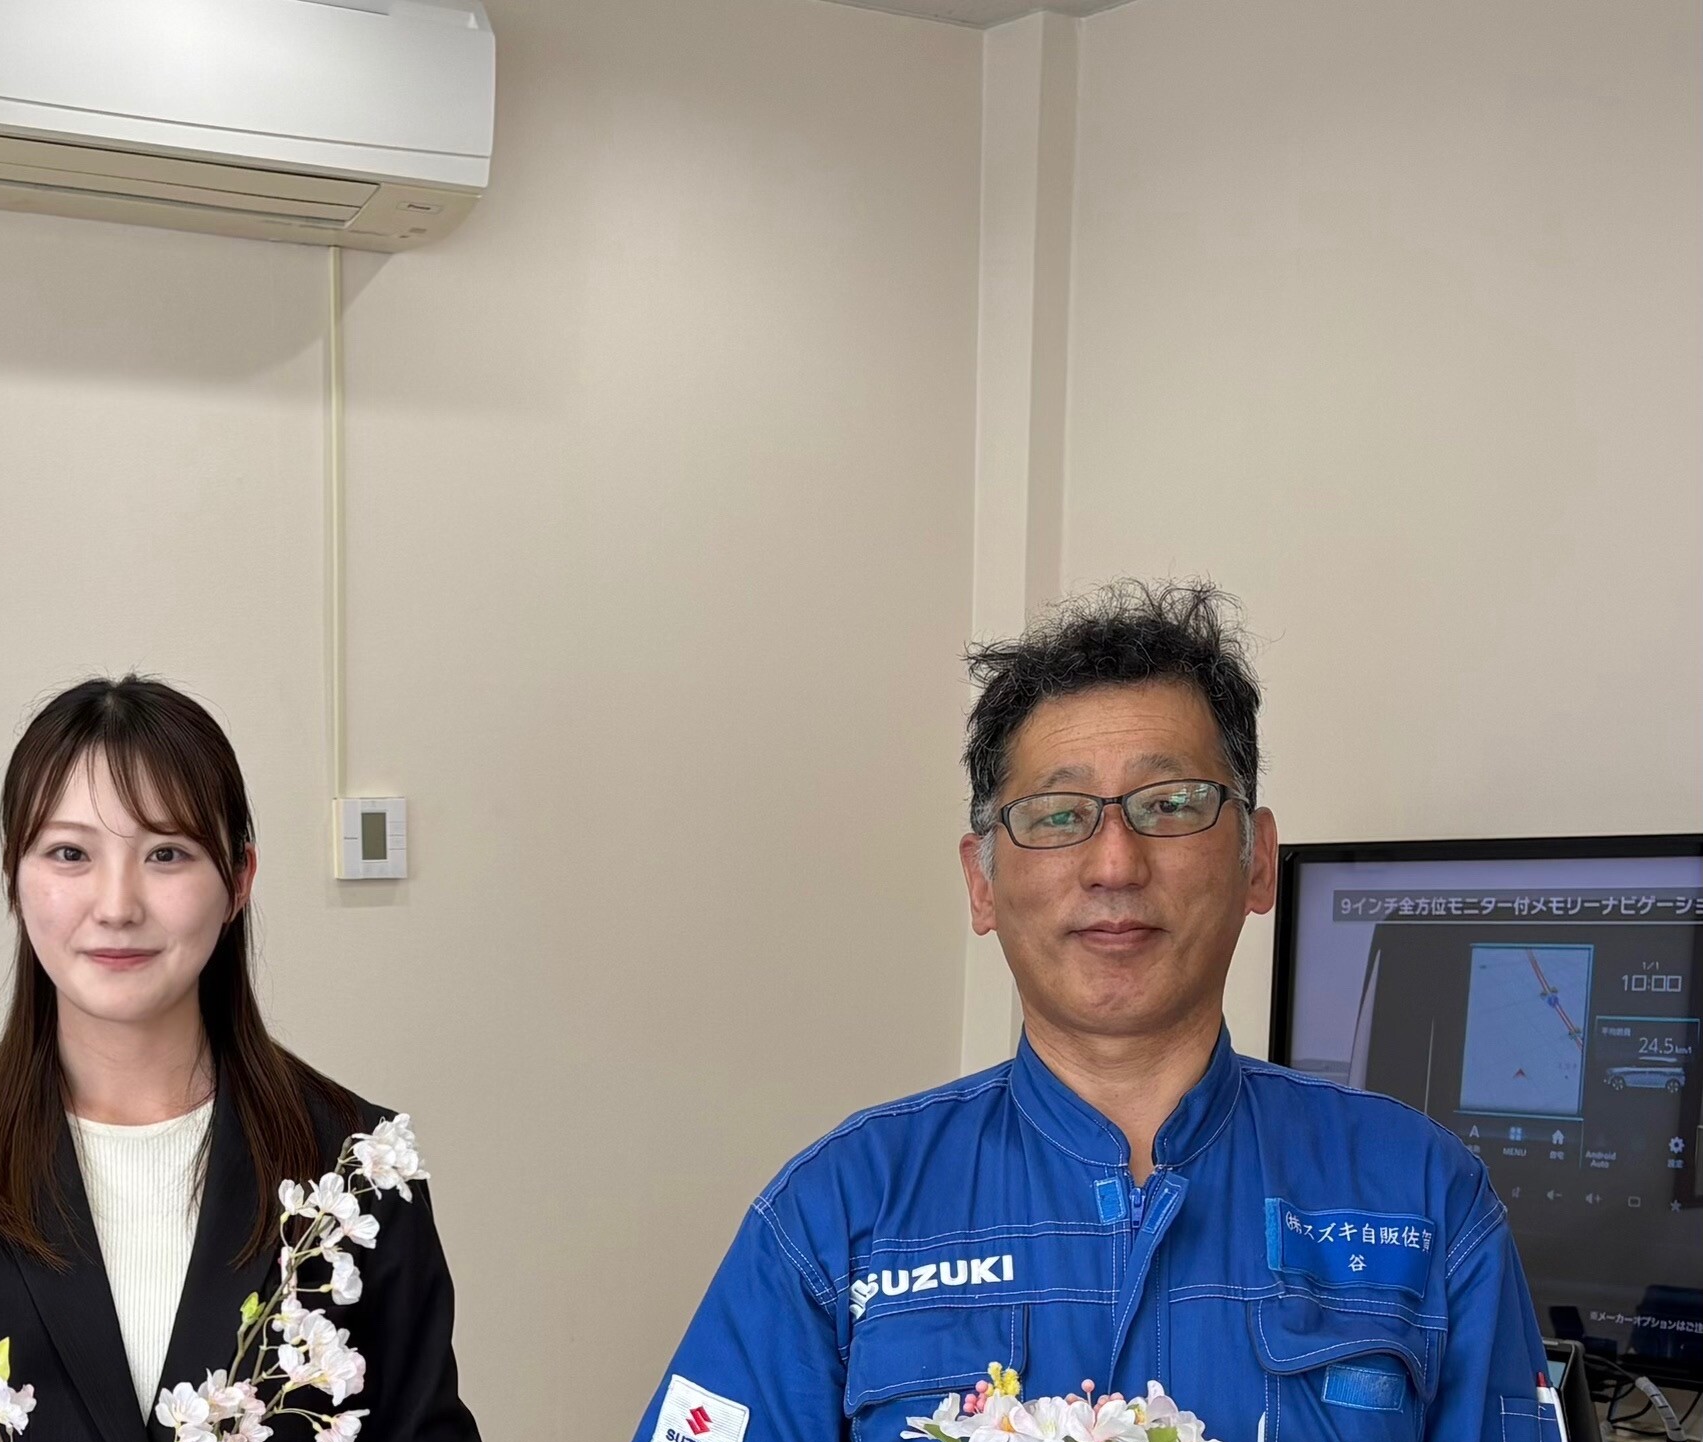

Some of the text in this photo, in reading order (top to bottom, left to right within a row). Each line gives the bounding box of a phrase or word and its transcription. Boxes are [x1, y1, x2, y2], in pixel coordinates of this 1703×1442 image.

[1621, 974, 1683, 992] 10:00
[1638, 1036, 1674, 1055] 24.5
[1503, 1147, 1527, 1157] MENU
[1585, 1150, 1616, 1161] Android
[1590, 1160, 1610, 1168] Auto
[1347, 1253, 1367, 1272] 谷
